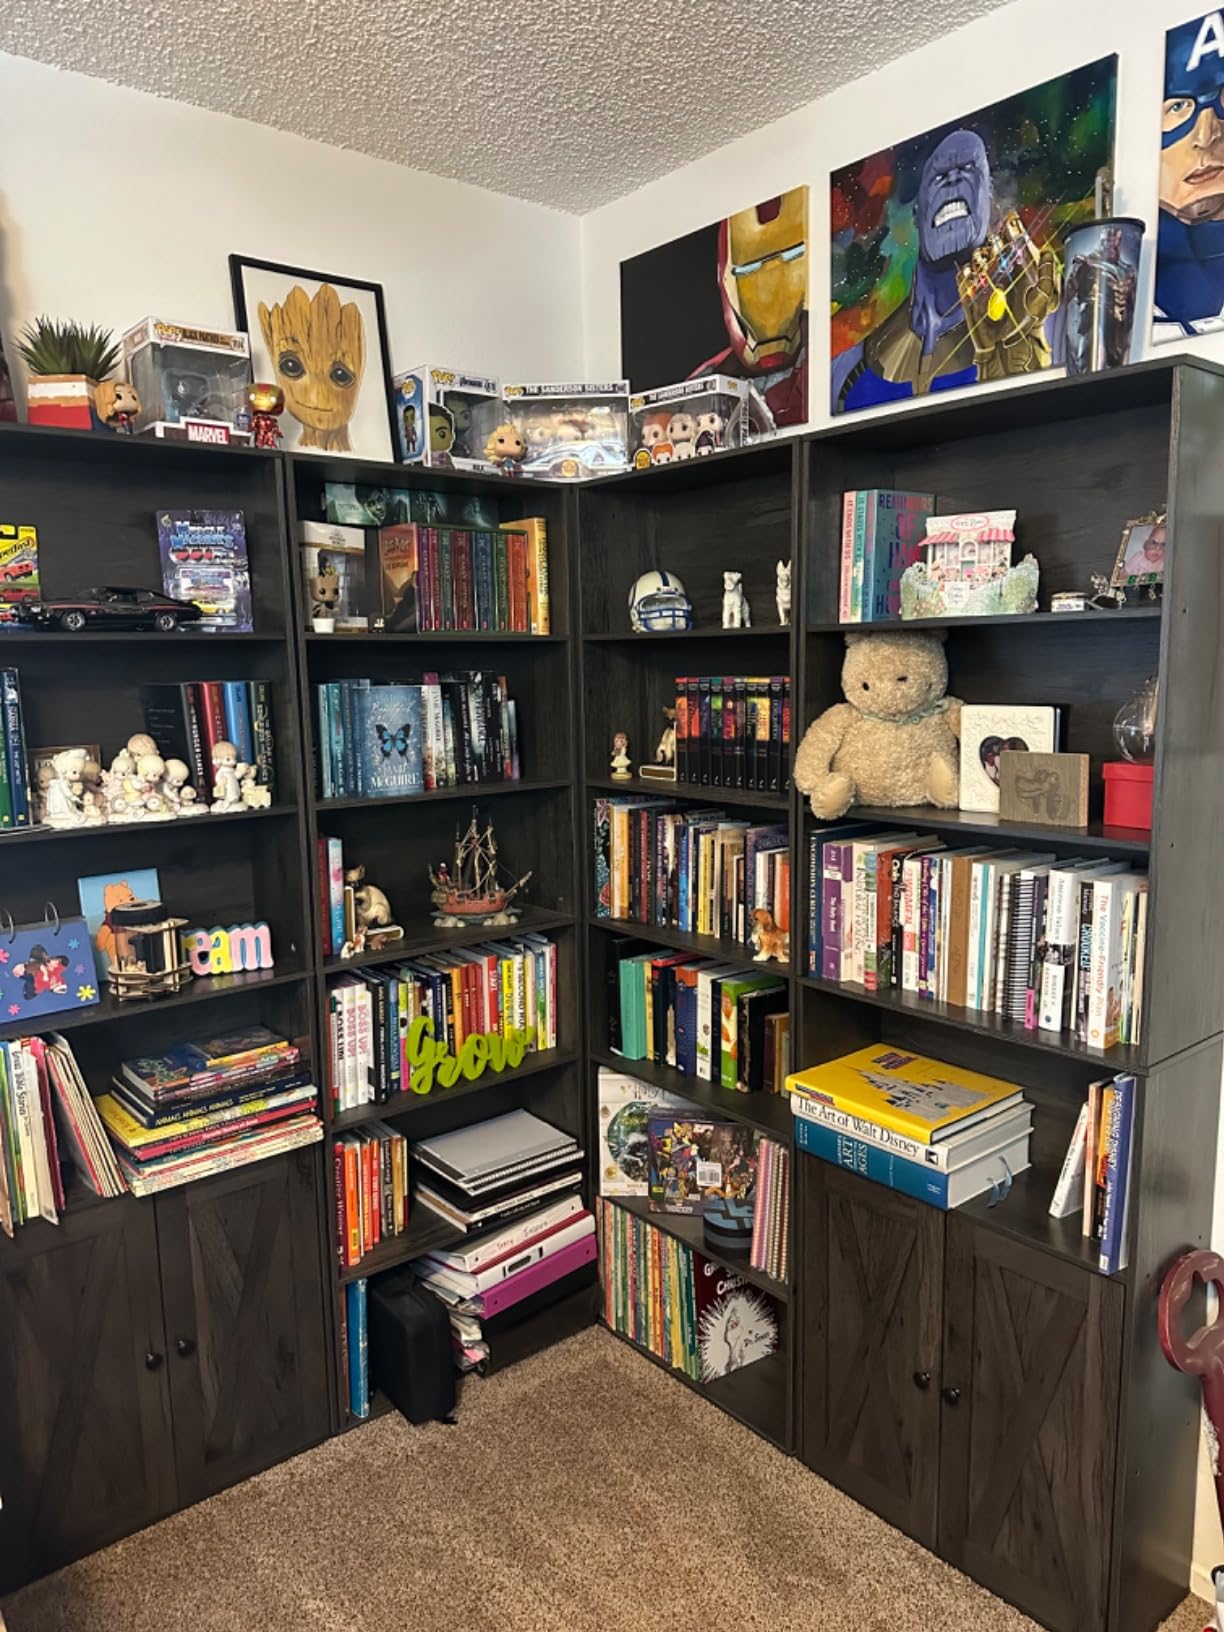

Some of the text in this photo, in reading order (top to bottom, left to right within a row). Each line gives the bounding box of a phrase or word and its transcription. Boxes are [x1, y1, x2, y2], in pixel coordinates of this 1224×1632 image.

[526, 385, 538, 394] THE
[540, 384, 583, 394] SANDERSON
[585, 383, 613, 392] SISTERS
[187, 424, 229, 445] MARVEL
[191, 724, 201, 752] HUNGER
[196, 753, 204, 776] GAMES
[181, 921, 275, 976] ream
[1094, 895, 1110, 1018] The Vaccine-Friendly Plan
[346, 1007, 357, 1058] BOSS UP!
[357, 1003, 369, 1055] BOSS UP!
[11, 1050, 23, 1070] Great
[406, 1015, 534, 1095] Grow
[14, 1071, 26, 1090] Bible
[16, 1091, 28, 1116] Stories
[1110, 1089, 1123, 1138] DESIGNING
[799, 1098, 920, 1157] The Art of Walt Disney
[843, 1137, 853, 1169] ART
[858, 1143, 868, 1175] AGES
[1107, 1139, 1119, 1171] DISNEY
[334, 1157, 343, 1199] Creative
